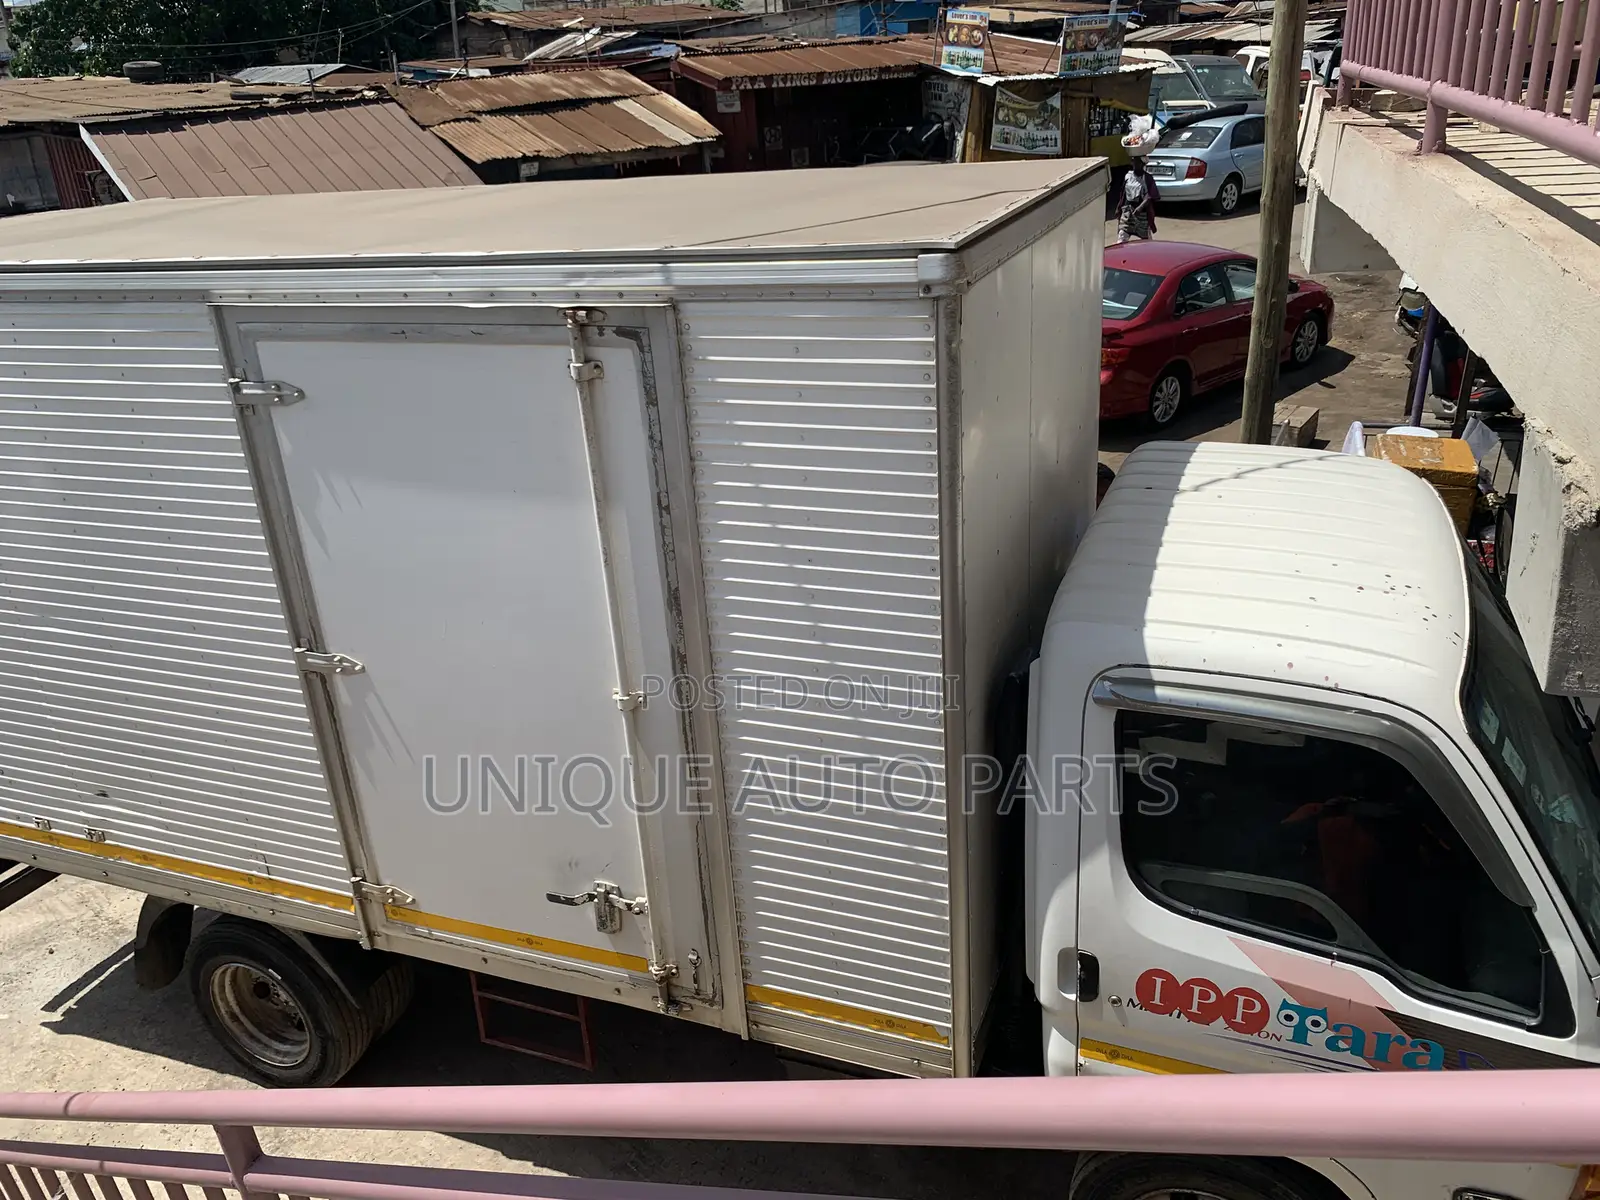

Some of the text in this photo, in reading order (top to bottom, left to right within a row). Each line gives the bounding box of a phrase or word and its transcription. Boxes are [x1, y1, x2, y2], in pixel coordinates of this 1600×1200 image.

[771, 73, 818, 88] KINGS
[822, 68, 880, 85] MOTORS
[1276, 998, 1445, 1072] Tara
